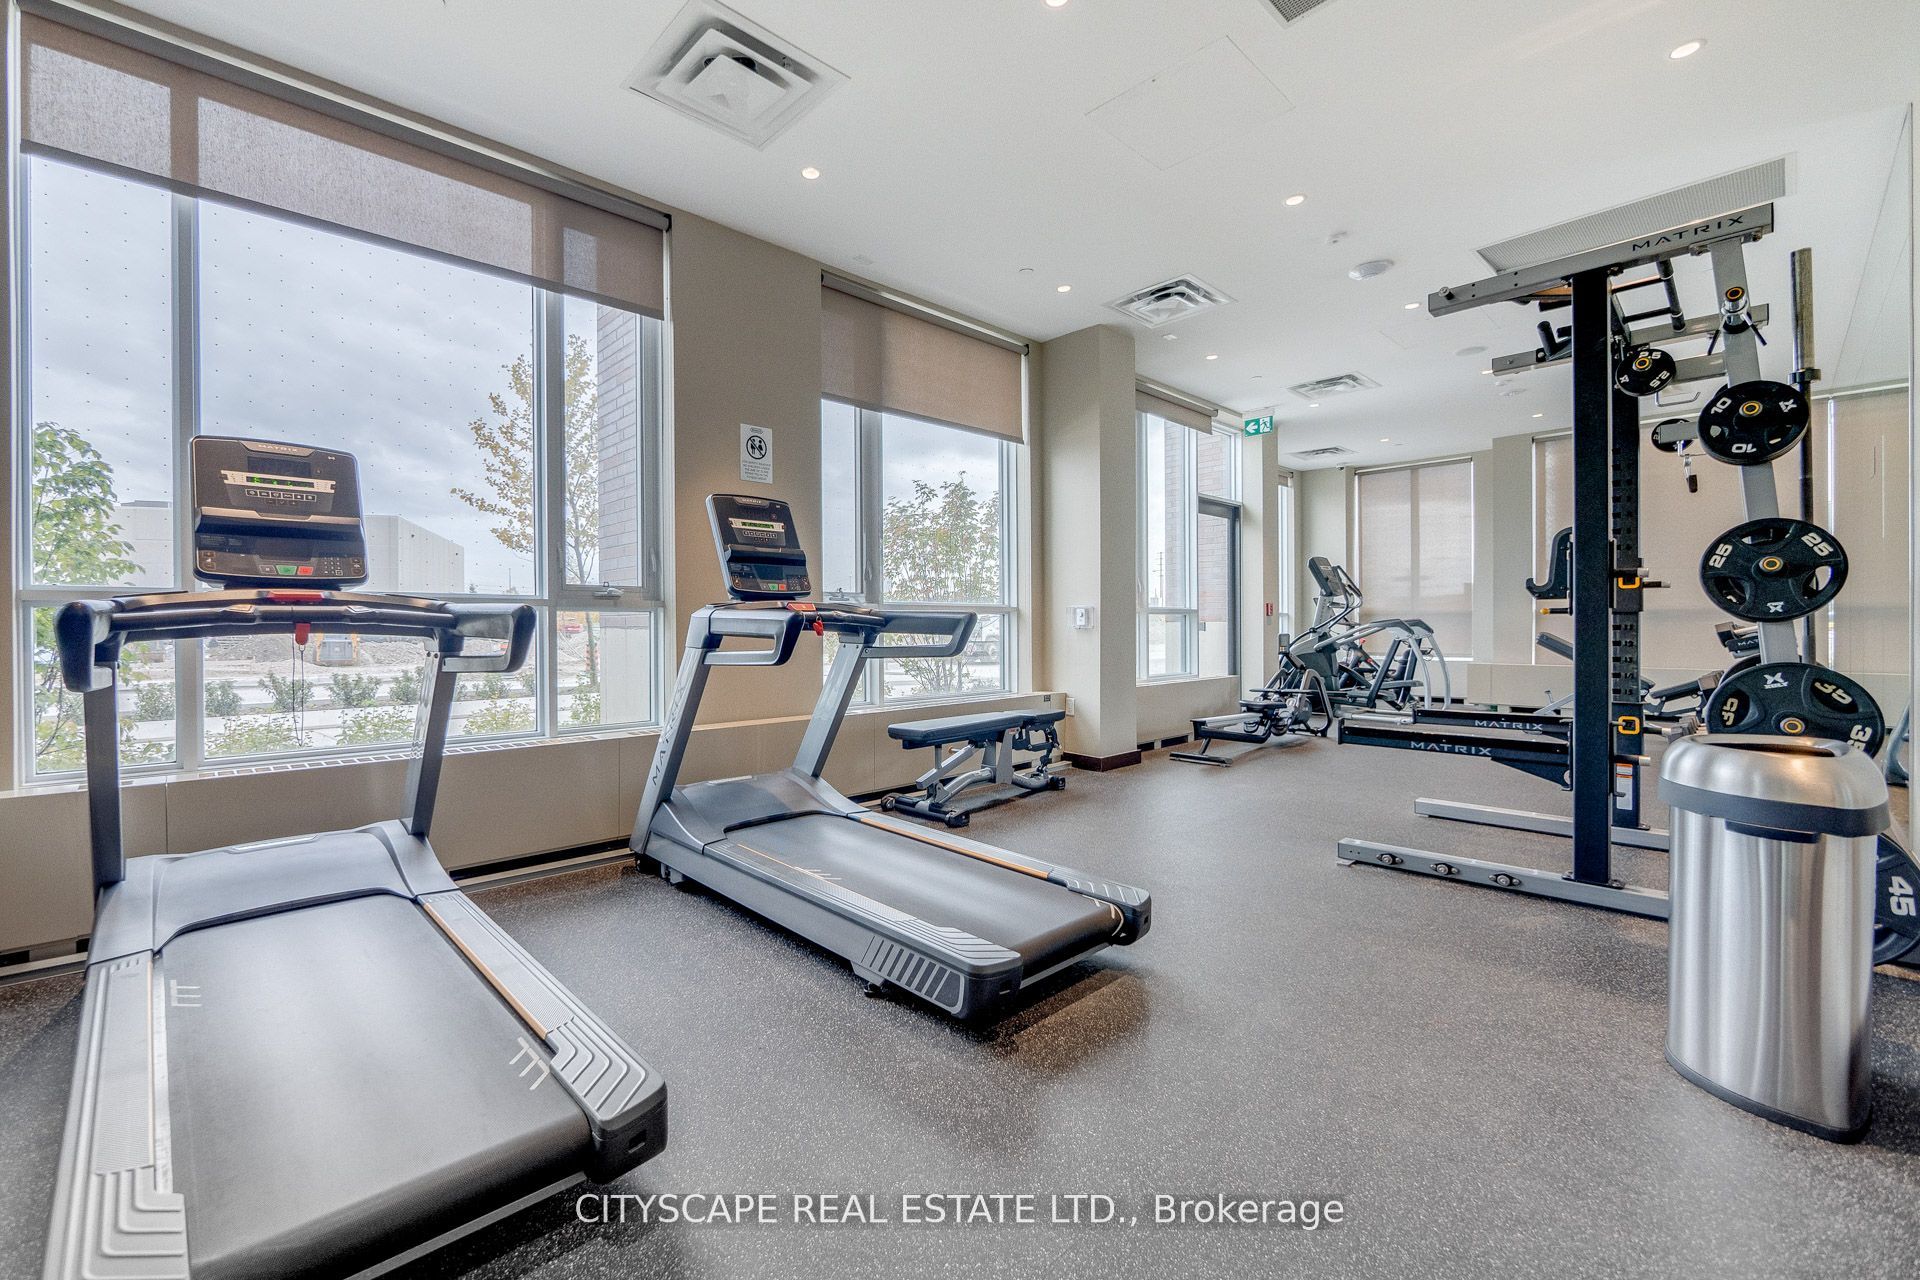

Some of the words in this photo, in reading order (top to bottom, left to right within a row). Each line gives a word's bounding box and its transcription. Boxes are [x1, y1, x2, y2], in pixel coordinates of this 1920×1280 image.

[1632, 215, 1744, 252] MATRIX
[1649, 370, 1670, 388] 2.5
[1710, 397, 1732, 415] 10
[1731, 443, 1757, 453] 10
[1801, 532, 1834, 557] 25
[1708, 543, 1733, 569] 25
[1475, 719, 1544, 730] MATRIX
[1410, 740, 1492, 756] MATRIX
[1888, 875, 1917, 917] 45
